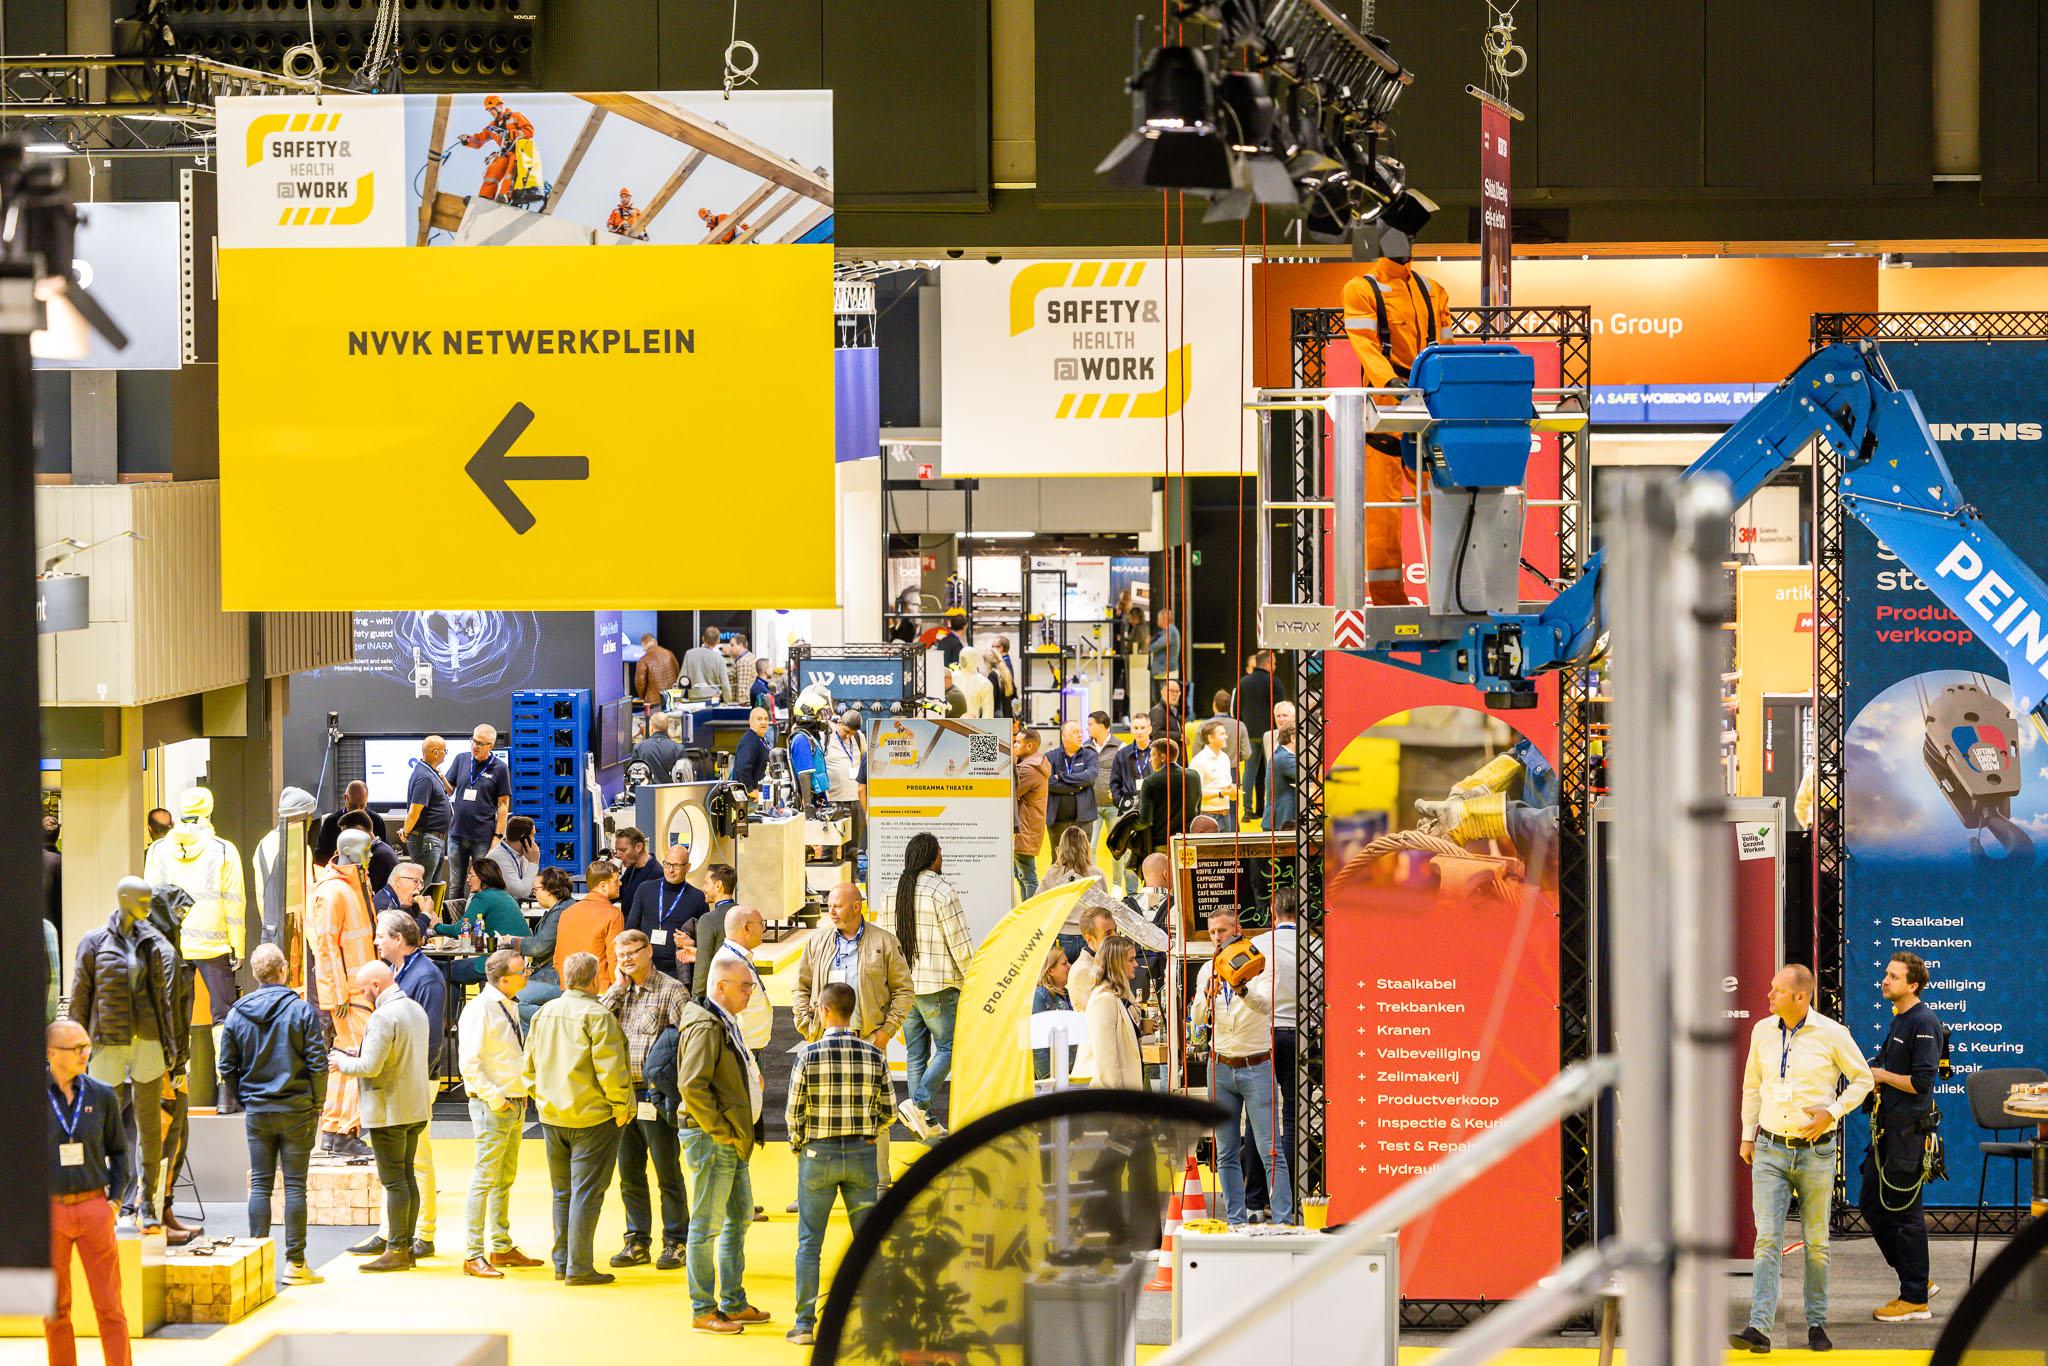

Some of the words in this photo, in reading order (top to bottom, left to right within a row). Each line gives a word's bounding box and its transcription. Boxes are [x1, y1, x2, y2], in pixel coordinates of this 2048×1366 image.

[272, 141, 351, 158] SAFETY&
[290, 163, 334, 176] HEALTH
[277, 182, 348, 198] @WORK
[1047, 300, 1160, 323] SAFETY&
[1610, 313, 1683, 339] Group
[349, 331, 432, 356] NVVK
[443, 329, 695, 355] NETWERKPLEIN
[1073, 331, 1135, 350] HEALTH
[1054, 357, 1155, 381] @WORK
[1594, 393, 1606, 405] A
[1607, 393, 1639, 405] SAFE
[1640, 393, 1702, 405] WORKING
[1704, 393, 1731, 406] DAY,
[1739, 527, 1757, 544] 3M
[1935, 540, 2048, 682] PEIN
[375, 617, 393, 625] with
[1275, 621, 1320, 633] HYRAX
[369, 629, 393, 639] guard
[1876, 626, 1973, 646] verkoop
[367, 642, 393, 650] INARA
[838, 673, 894, 686] wenaas
[906, 784, 945, 792] PROGRAMMA
[946, 784, 974, 792] THEATER
[1891, 917, 1964, 927] Staalkabel
[1891, 938, 1972, 948] Trekbanken
[1376, 978, 1457, 990] Staalkabel
[1923, 979, 1986, 991] eveiliging
[1376, 1001, 1465, 1013] Trekbanken
[1377, 1024, 1431, 1036] Kranen
[1377, 1047, 1481, 1062] Valbeveiliging
[1957, 1042, 1968, 1052] &
[1970, 1042, 2024, 1054] Keuring
[1950, 1063, 1983, 1074] epair
[1377, 1071, 1460, 1084] Zeilmakerij
[1377, 1094, 1500, 1107] Productverkoop
[1377, 1117, 1447, 1130] Inspectie
[1450, 1117, 1461, 1129] &
[1377, 1140, 1410, 1151] Test
[1413, 1140, 1424, 1151] &
[1428, 1141, 1473, 1153] Repai
